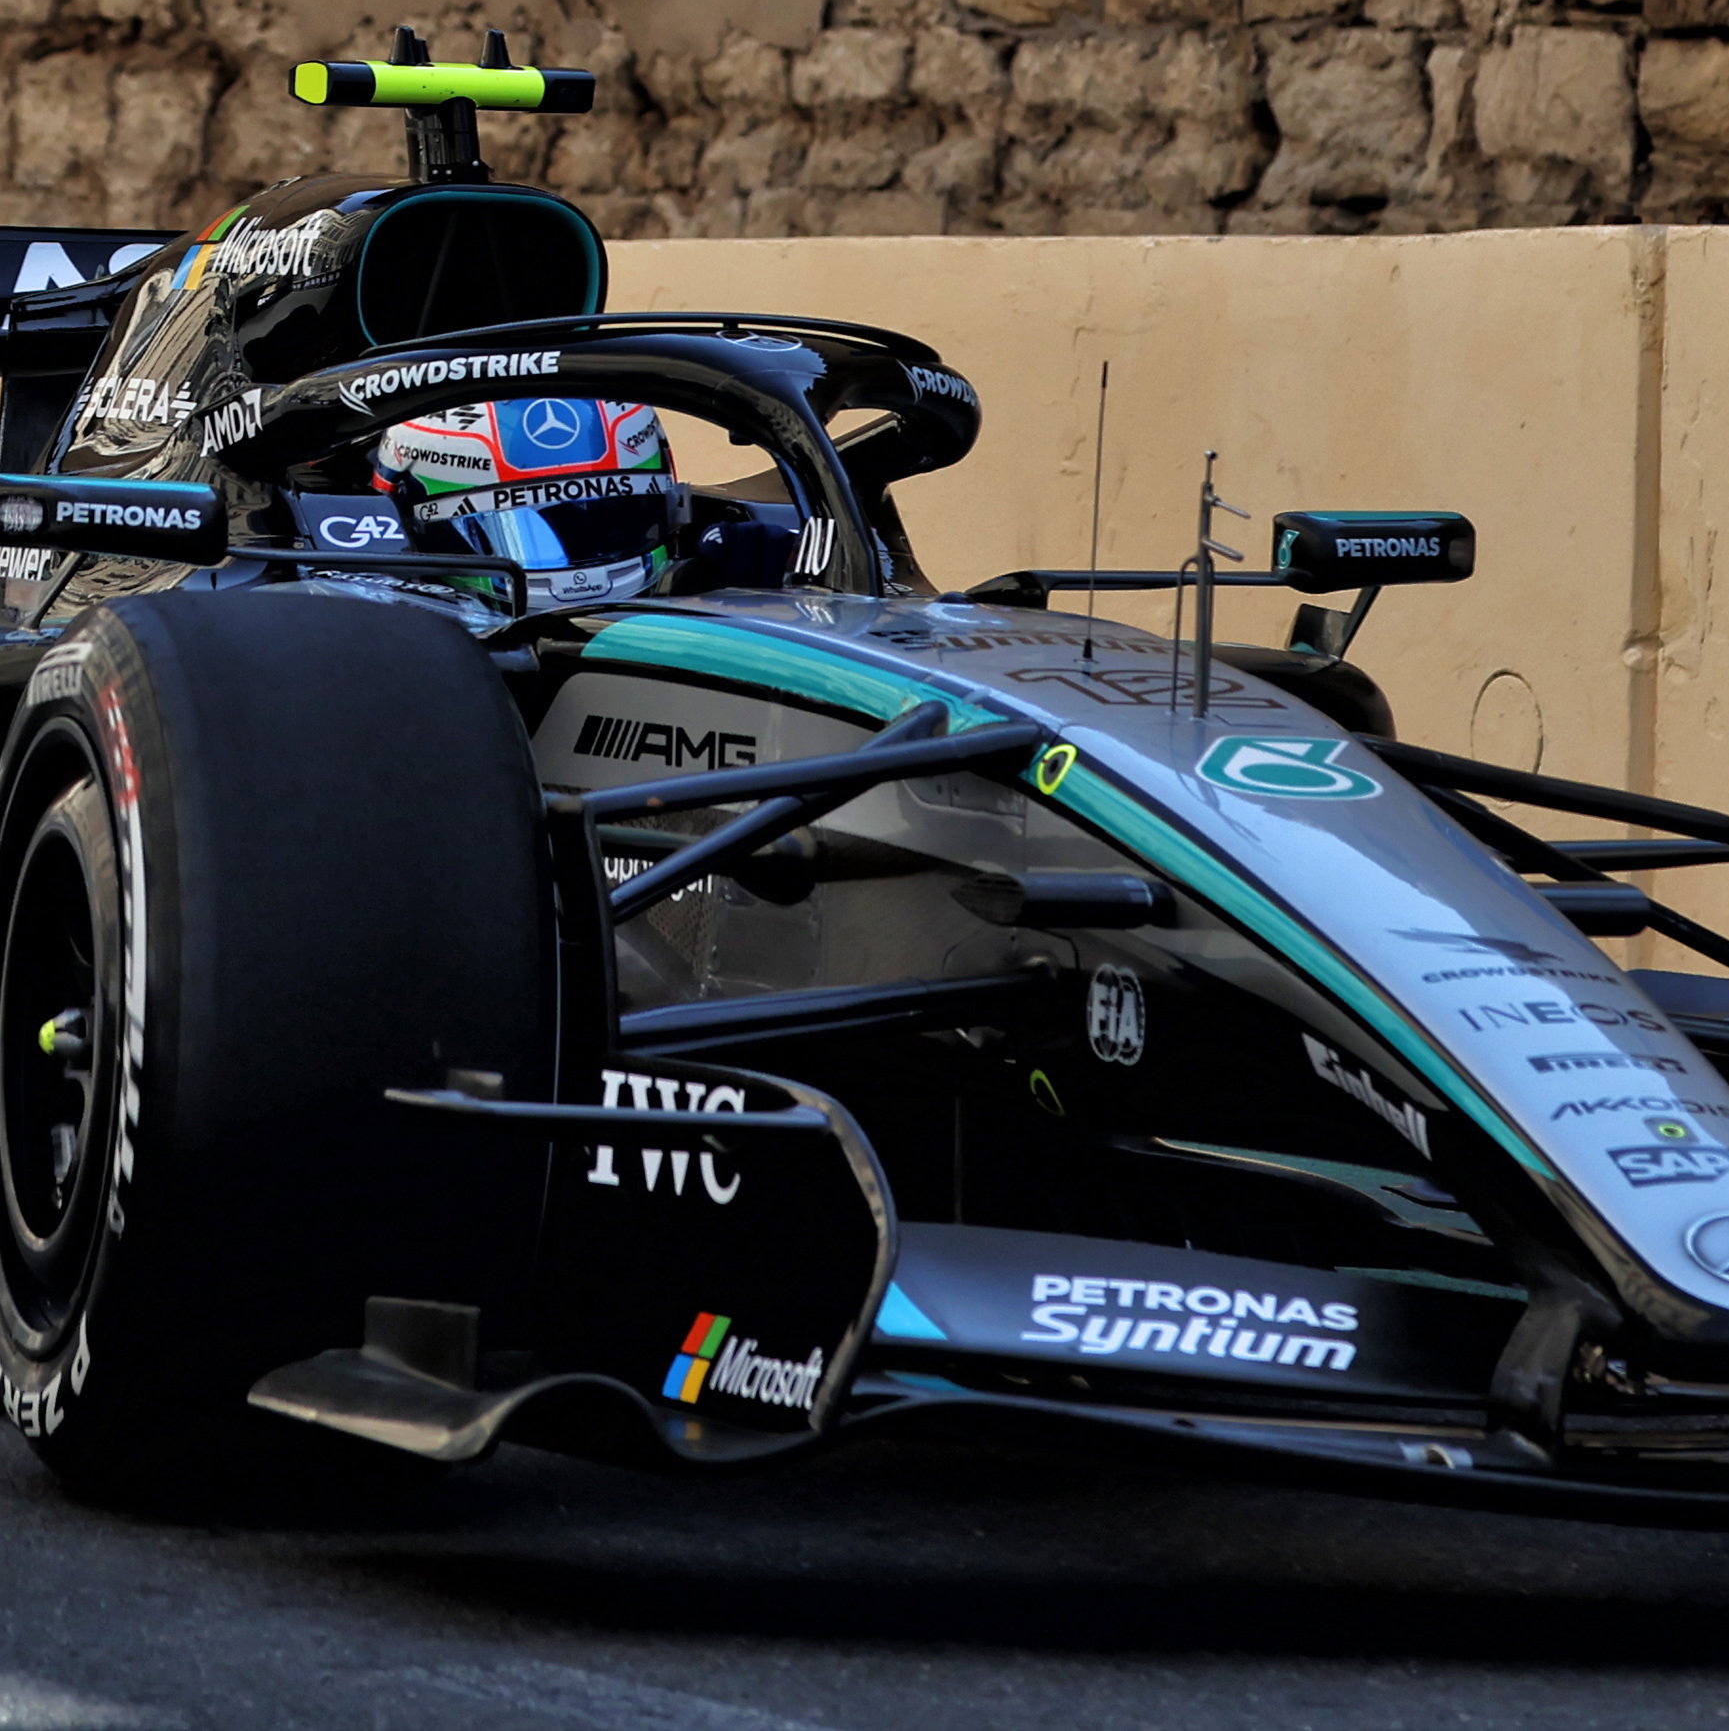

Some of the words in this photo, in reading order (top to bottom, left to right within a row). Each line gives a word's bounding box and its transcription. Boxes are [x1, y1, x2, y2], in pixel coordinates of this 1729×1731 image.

[211, 211, 322, 276] Microsoft
[349, 350, 561, 400] CROWDSTRIKE
[83, 377, 168, 424] SOLERA
[200, 400, 245, 458] AMD
[398, 445, 491, 471] CROWDSTRIKE
[493, 476, 634, 510] PETRONAS
[56, 501, 201, 531] PETRONAS
[320, 515, 406, 549] G42
[1335, 537, 1440, 557] PETRONAS
[562, 584, 603, 595] WhatsApp
[1422, 969, 1620, 987] CROWDSTRIKE
[1091, 983, 1142, 1047] FIA
[1458, 1001, 1667, 1033] INEOS
[1526, 1053, 1688, 1074] PIRELLI
[1302, 1032, 1432, 1162] Einhell
[1032, 1274, 1359, 1330] PETRONAS
[1021, 1302, 1357, 1371] Syntium
[709, 1335, 823, 1410] Microsoft
